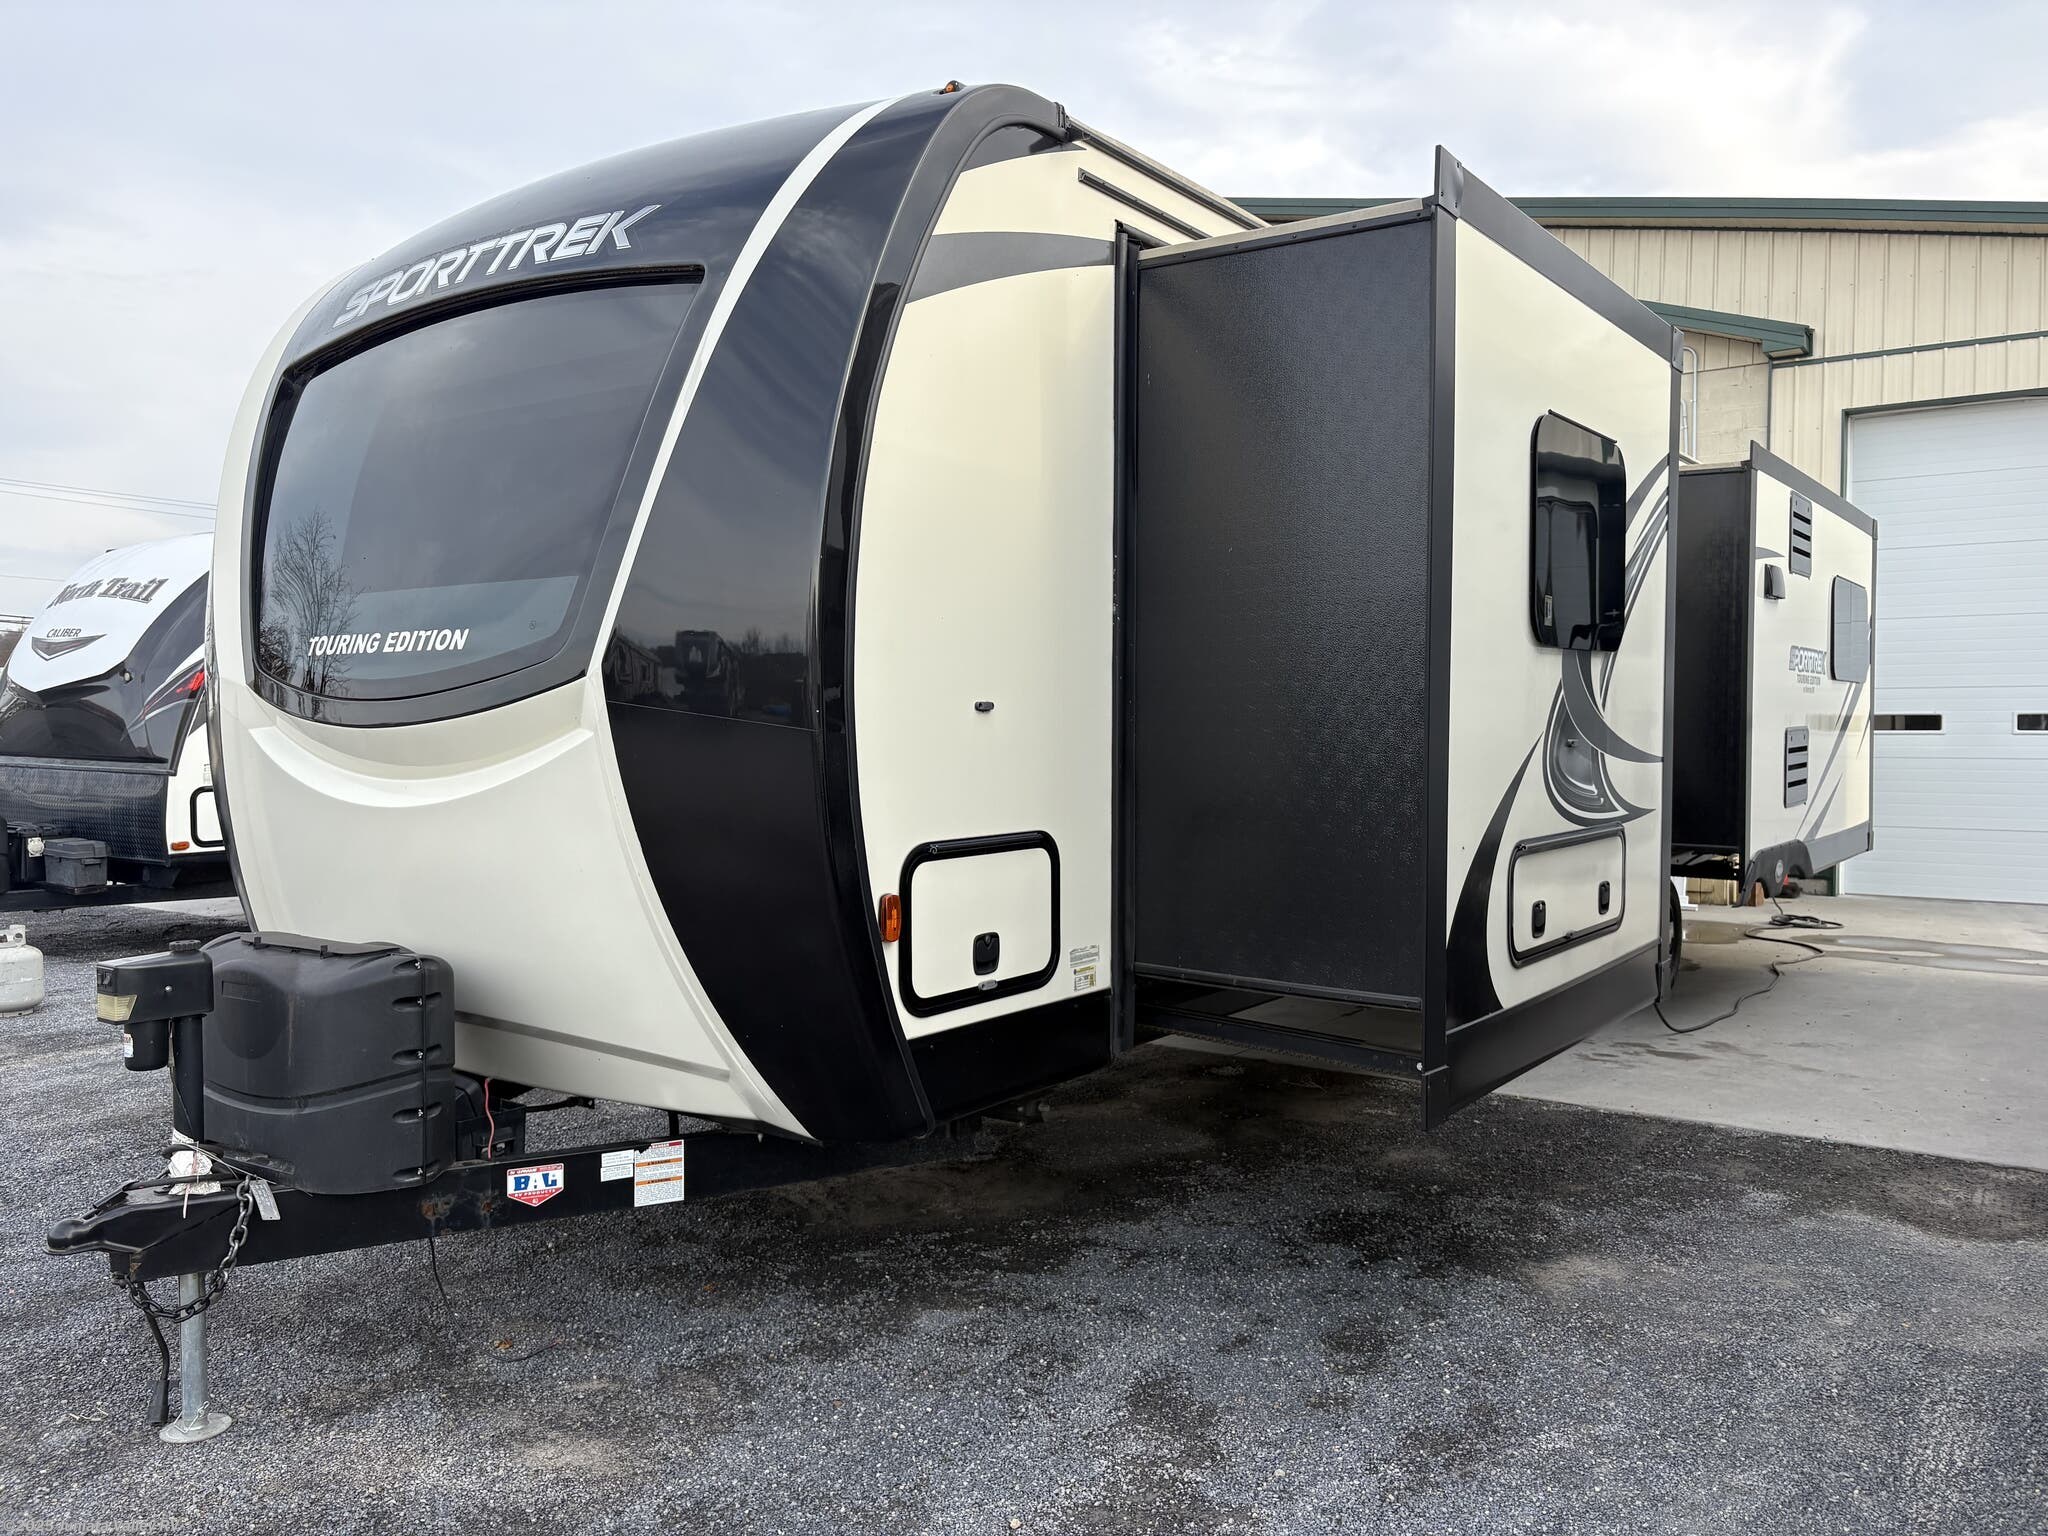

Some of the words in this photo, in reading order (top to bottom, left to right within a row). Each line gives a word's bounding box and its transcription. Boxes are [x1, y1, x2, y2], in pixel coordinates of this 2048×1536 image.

[333, 204, 662, 328] SPORTTREK
[46, 578, 104, 609] North
[97, 577, 169, 604] Trail
[46, 628, 82, 638] CALIBER
[308, 632, 381, 656] TOURING
[383, 629, 469, 653] EDITION
[513, 1172, 558, 1191] BAL
